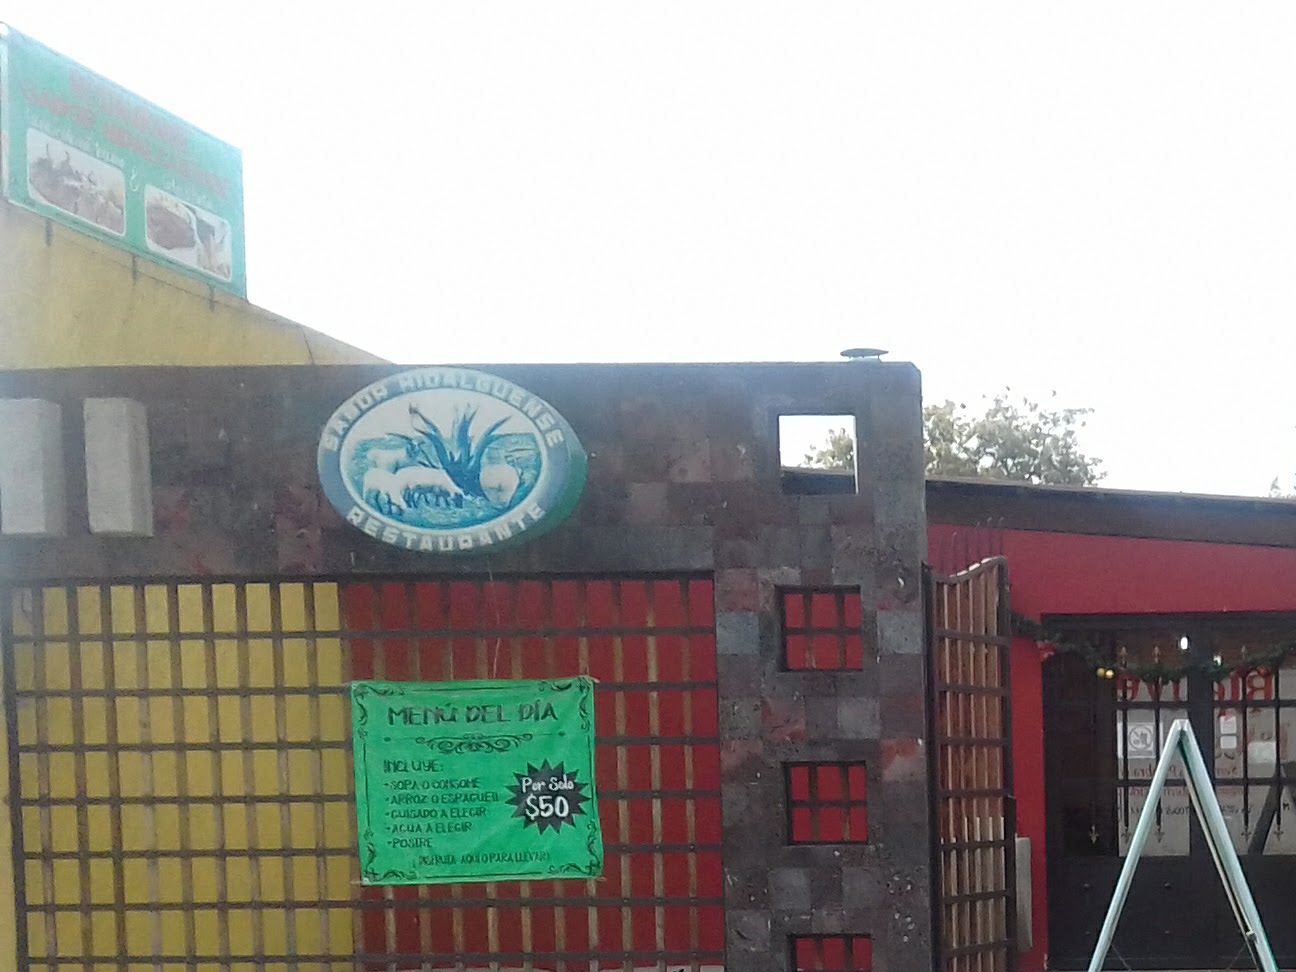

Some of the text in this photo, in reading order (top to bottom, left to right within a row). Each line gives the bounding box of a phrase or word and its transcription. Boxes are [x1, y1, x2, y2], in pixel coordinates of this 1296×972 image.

[323, 370, 565, 452] SABOR HIDALGUENSE
[345, 502, 547, 551] RESTAURANTE
[466, 704, 511, 723] DEL
[422, 780, 430, 790] O
[521, 774, 574, 793] Por Solo
[431, 795, 439, 804] O
[525, 793, 569, 820] $50
[440, 808, 448, 818] A
[425, 822, 433, 833] A
[435, 822, 472, 833] ELEGIR
